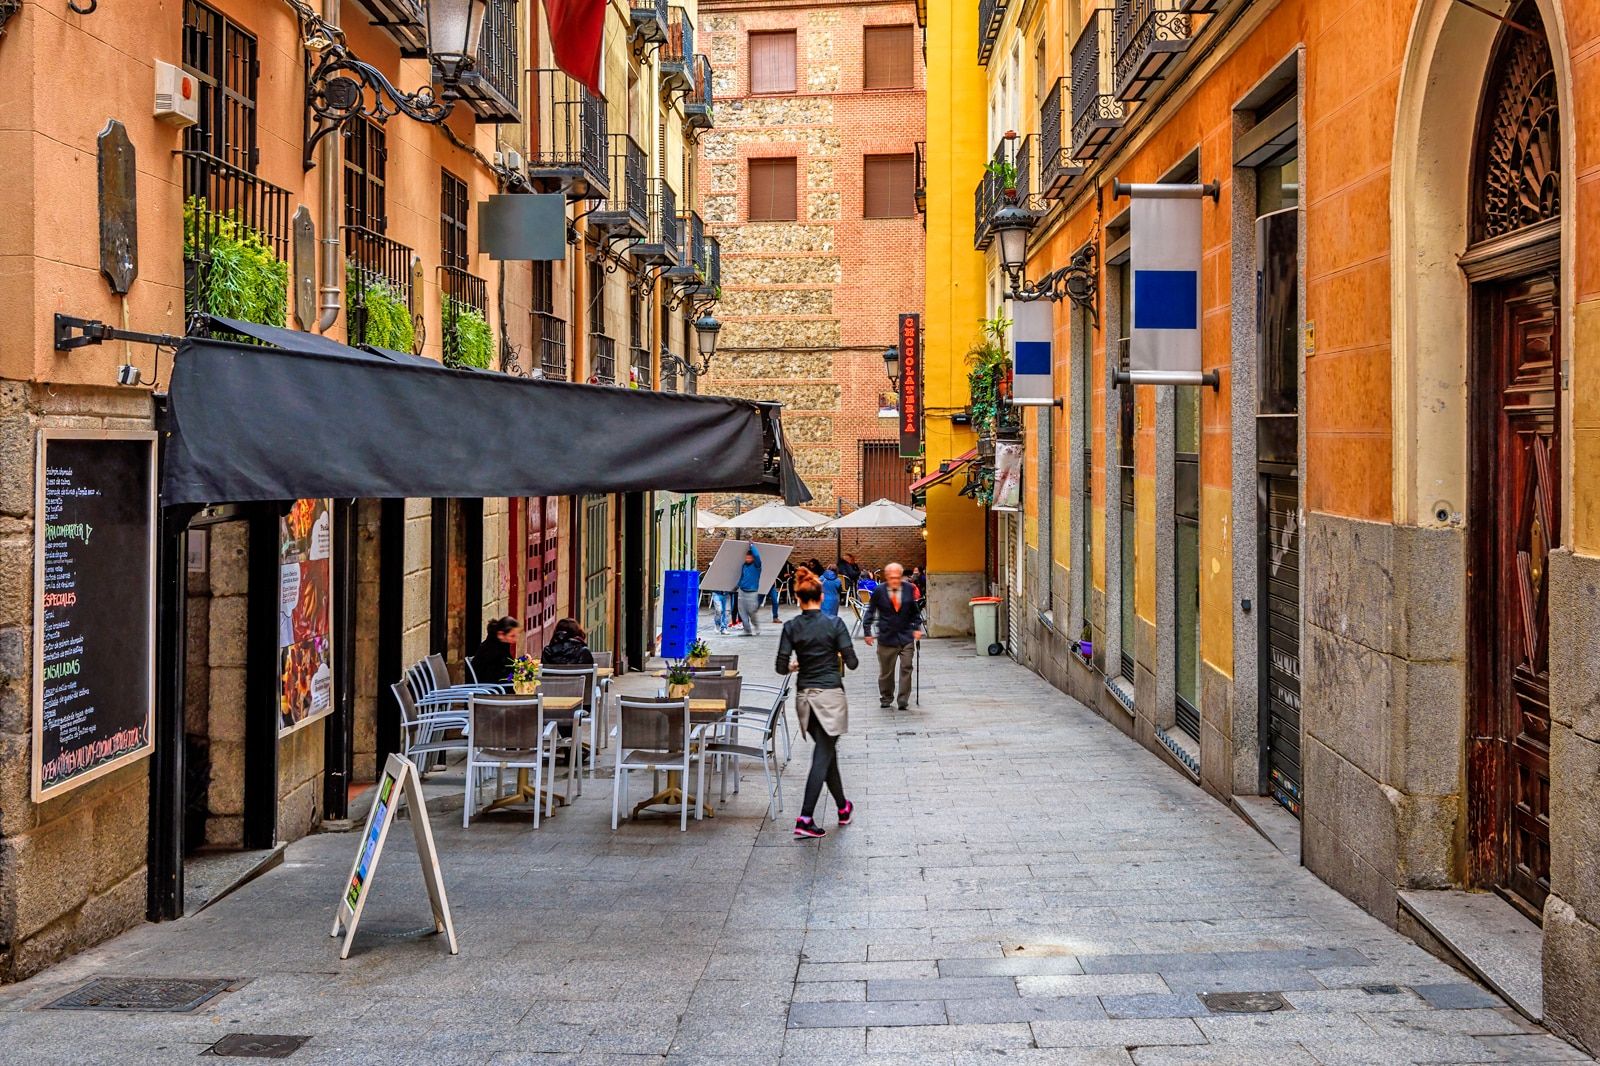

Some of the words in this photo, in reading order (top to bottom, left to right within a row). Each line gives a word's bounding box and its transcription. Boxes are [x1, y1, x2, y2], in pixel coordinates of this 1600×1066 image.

[904, 317, 915, 432] CHOCOLATERIA
[44, 592, 77, 607] ESPECIALES
[43, 659, 81, 681] ENSALADAS
